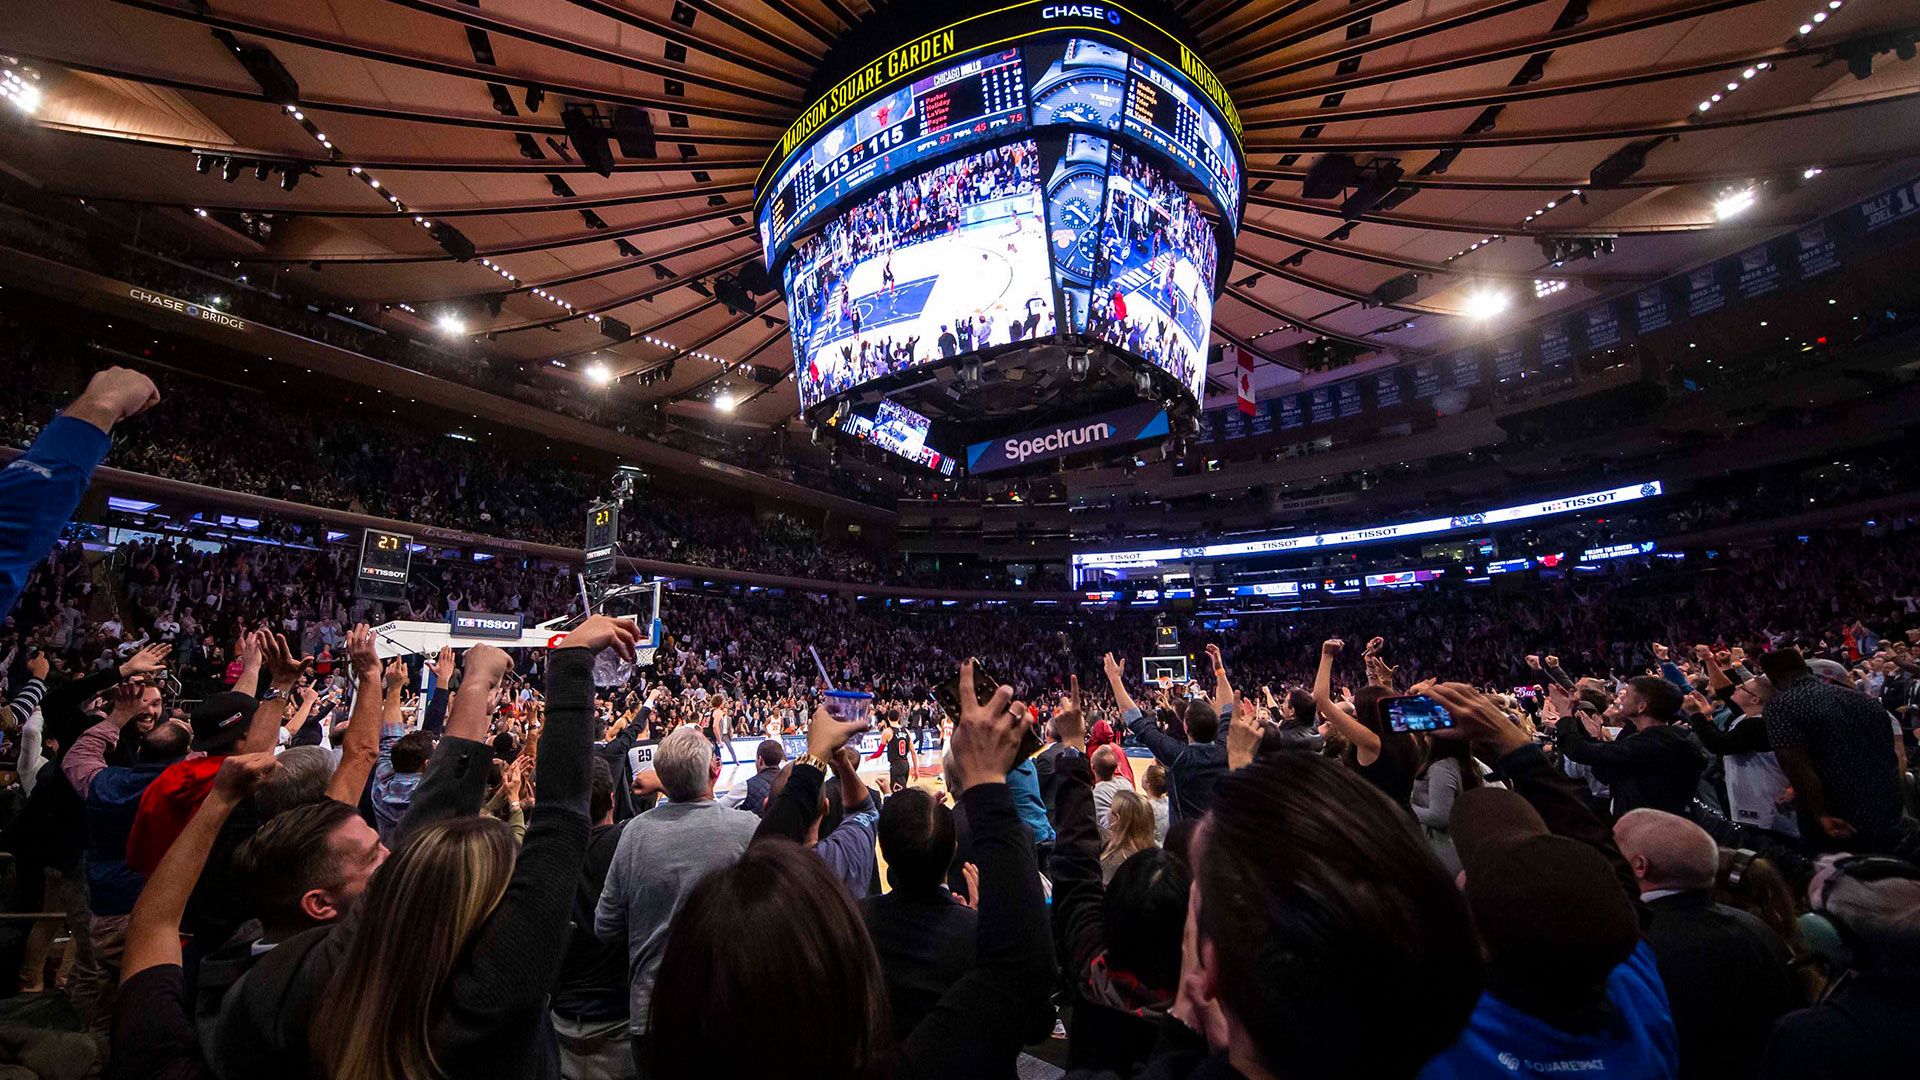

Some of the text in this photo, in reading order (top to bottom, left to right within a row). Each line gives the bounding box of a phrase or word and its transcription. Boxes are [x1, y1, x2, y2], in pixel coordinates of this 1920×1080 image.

[1042, 5, 1104, 20] CHASE
[933, 60, 982, 86] CHICAGO BULLS
[1180, 45, 1224, 108] MADISON
[782, 29, 954, 158] MADISON SQUARE GARDEN
[925, 91, 947, 105] Parker
[939, 133, 951, 144] 27
[974, 122, 987, 133] 45
[1009, 113, 1023, 124] 75
[1142, 128, 1153, 139] 27
[868, 125, 904, 155] 115
[853, 150, 864, 164] 2.7
[1203, 147, 1221, 177] 113
[822, 154, 849, 183] 113
[130, 289, 245, 330] CHASE BRIDGE
[1005, 422, 1109, 463] Spectrum
[1562, 491, 1617, 509] TISSOT
[1357, 527, 1399, 540] TISSOT
[378, 535, 398, 550] 2.7
[1262, 540, 1299, 550] TISSOT
[374, 568, 406, 578] TISSOT
[477, 618, 518, 630] TISSOT
[638, 748, 652, 763] 29
